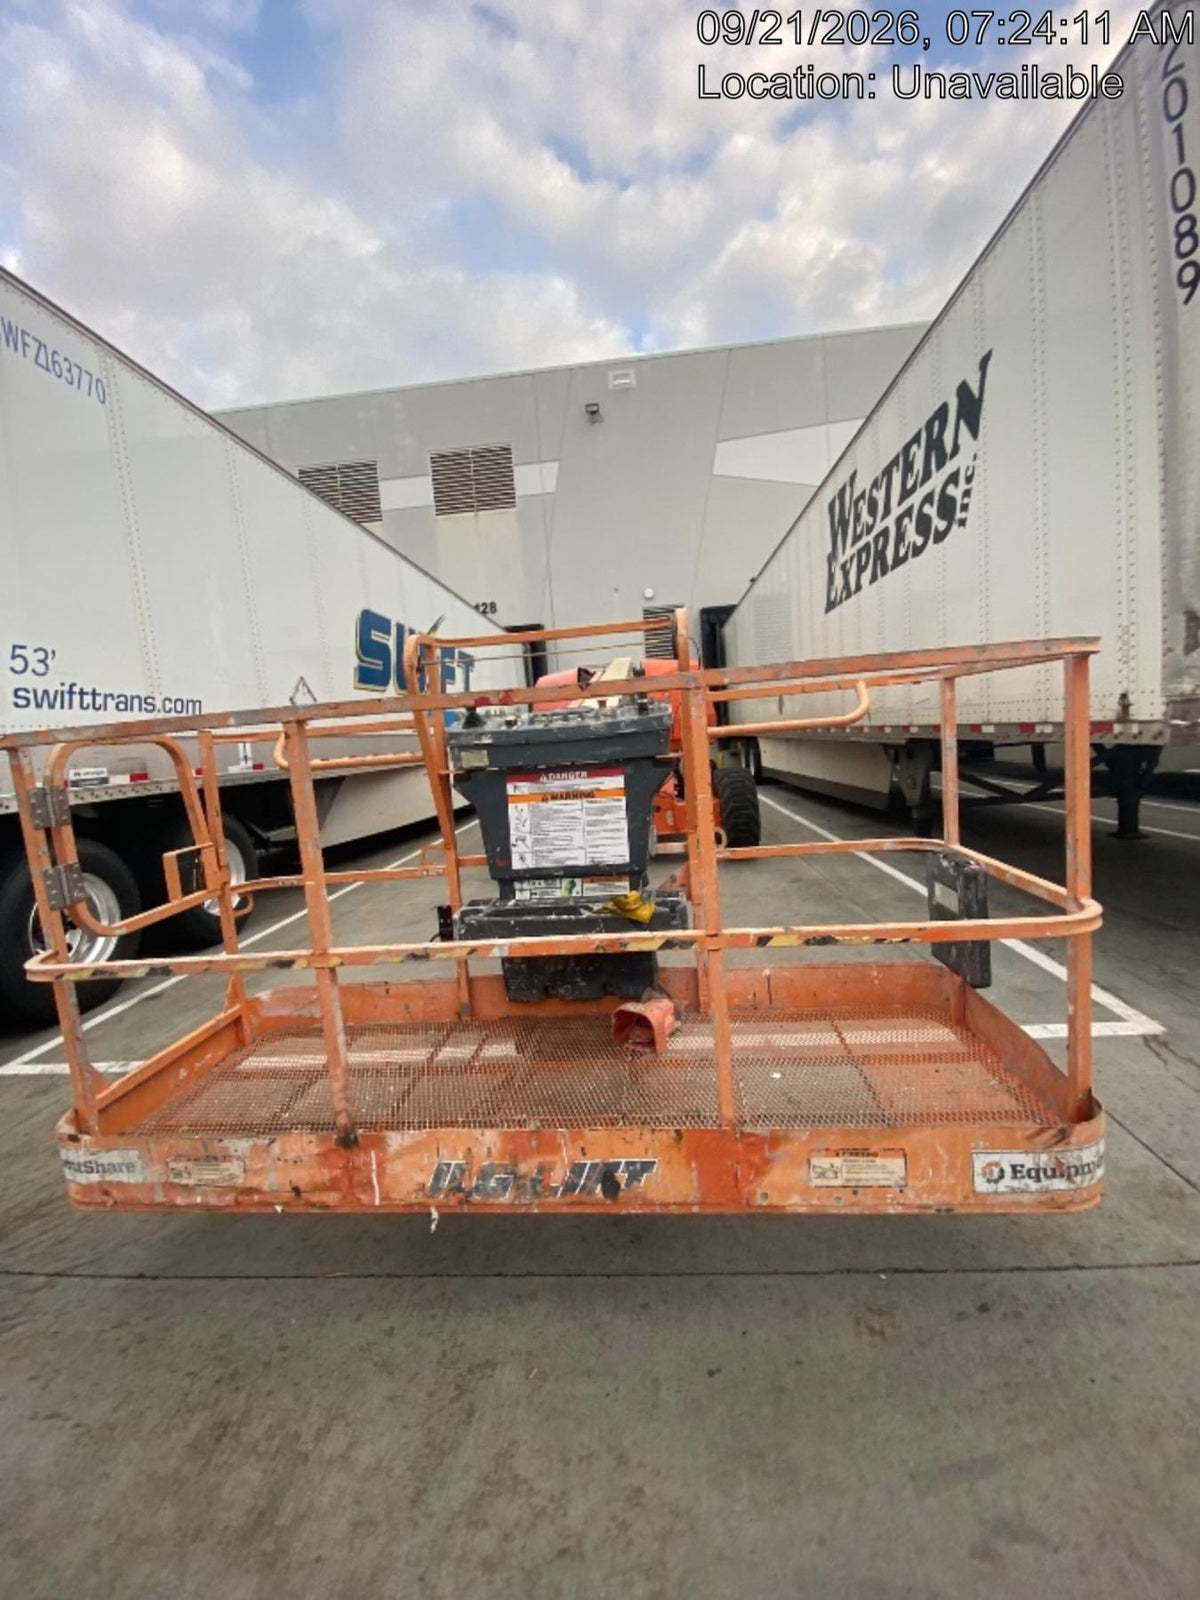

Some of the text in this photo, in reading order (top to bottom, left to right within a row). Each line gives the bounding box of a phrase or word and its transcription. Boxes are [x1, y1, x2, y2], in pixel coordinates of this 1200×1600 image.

[828, 347, 993, 562] WESTERN
[824, 466, 961, 614] EXPRESS
[13, 682, 202, 715] swifttrans.com
[548, 771, 588, 781] DANGER
[550, 790, 596, 801] WARNING
